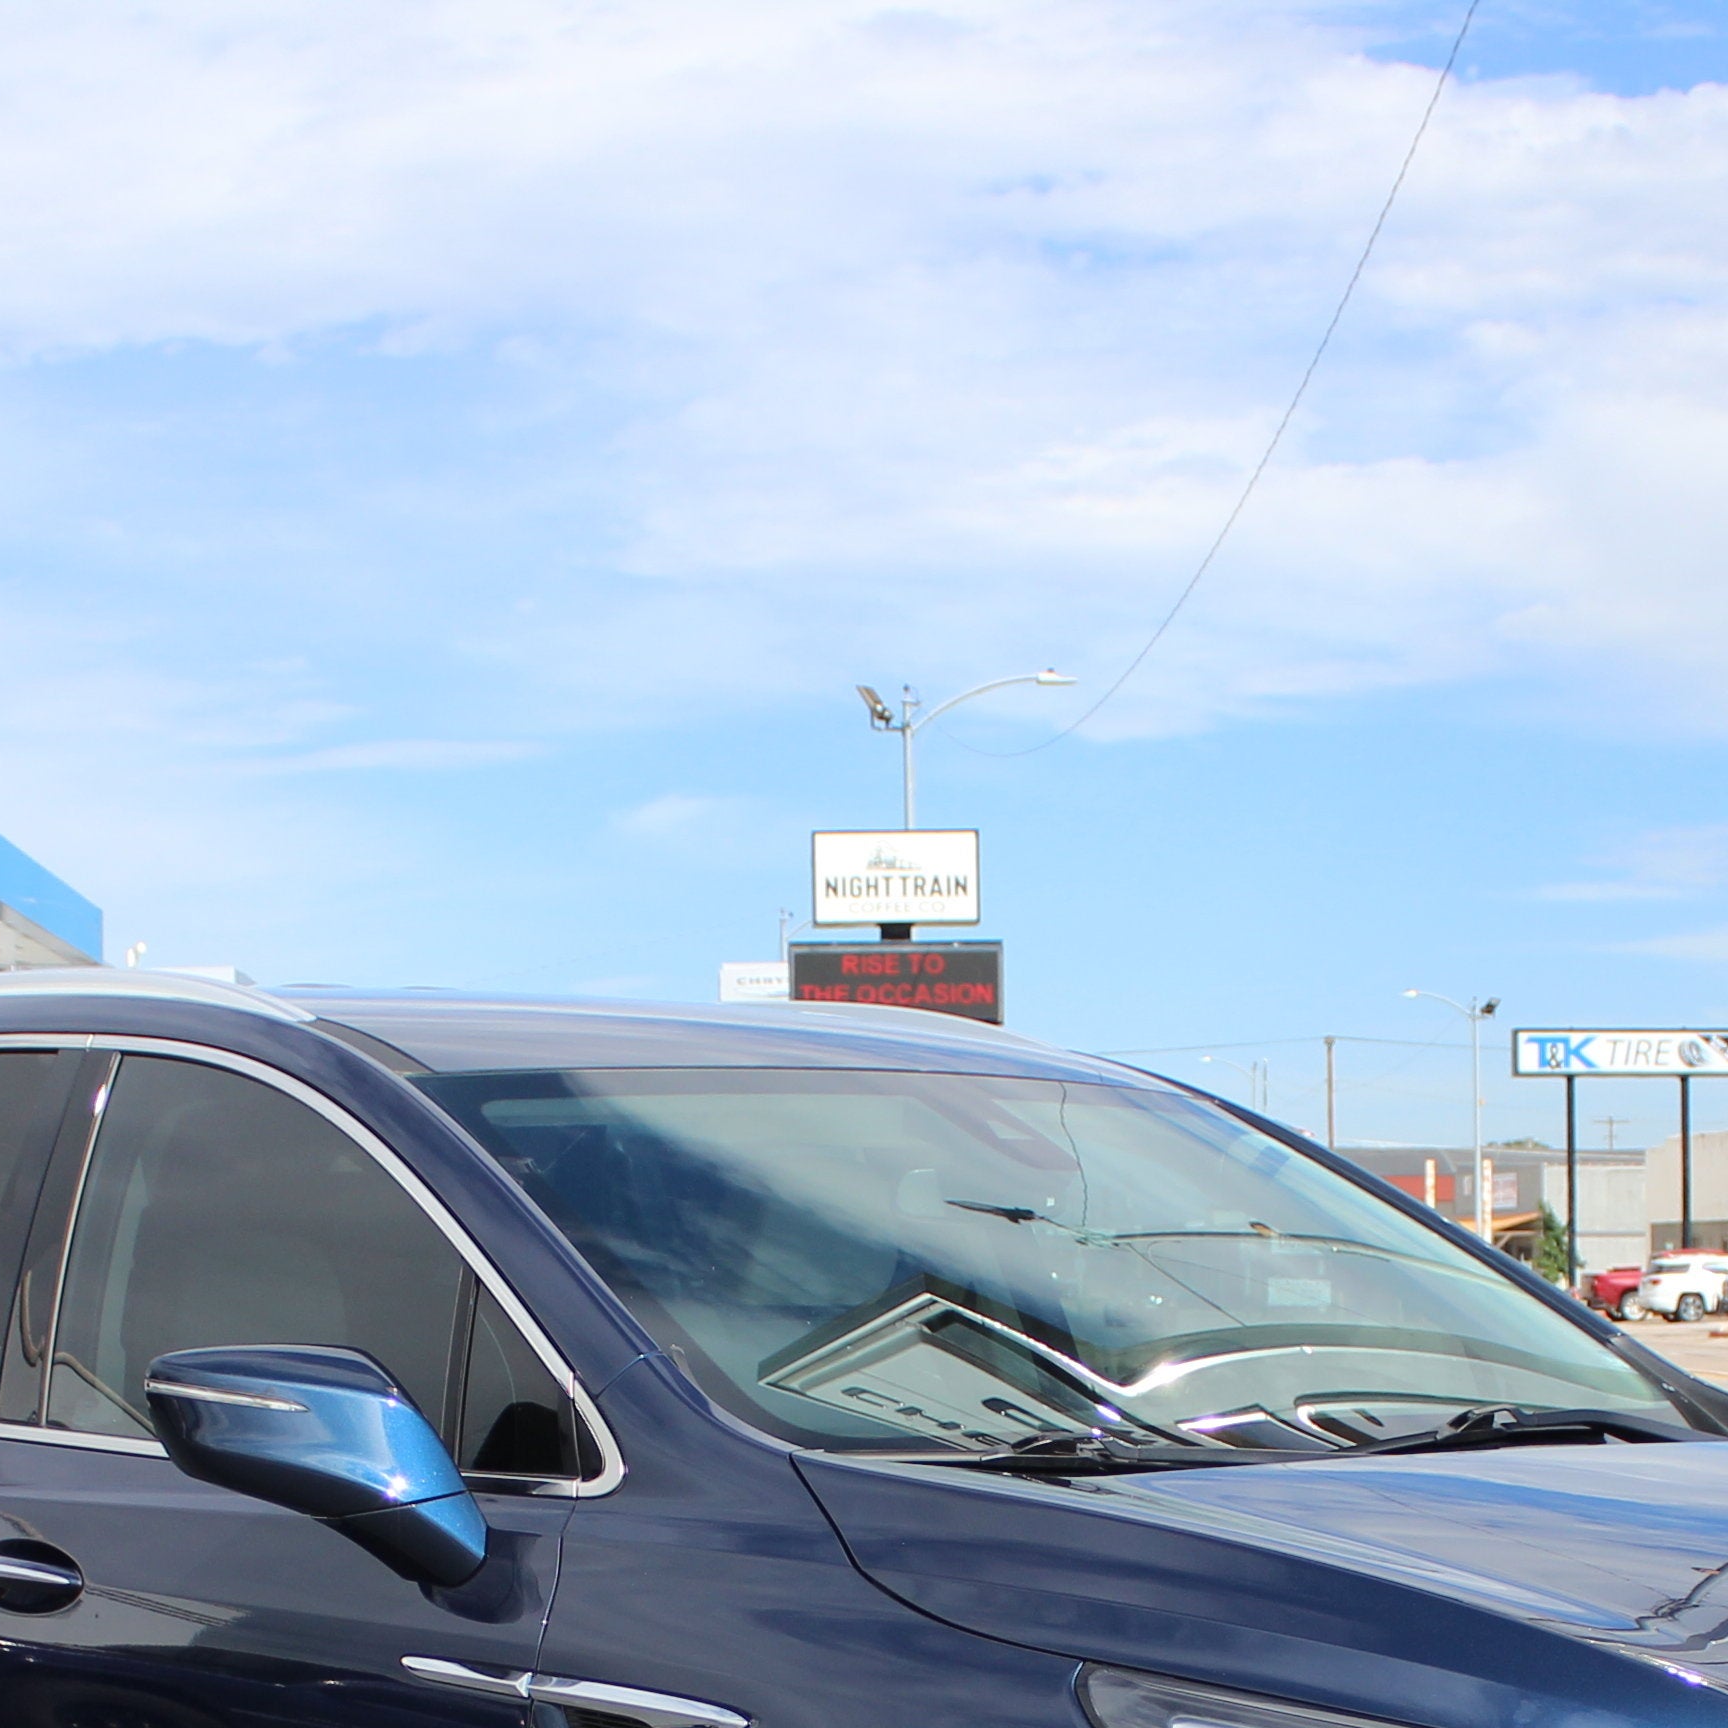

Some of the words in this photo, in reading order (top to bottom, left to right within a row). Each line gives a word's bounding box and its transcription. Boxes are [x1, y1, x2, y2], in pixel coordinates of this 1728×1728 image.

[825, 875, 893, 898] NIGHT
[899, 875, 968, 898] TRAIN
[848, 901, 912, 913] COFFEE
[840, 953, 900, 976] RISE
[909, 953, 946, 975] TO
[857, 983, 994, 1006] OCCASION
[1525, 1034, 1600, 1070] T&K
[1606, 1038, 1673, 1067] TIRE
